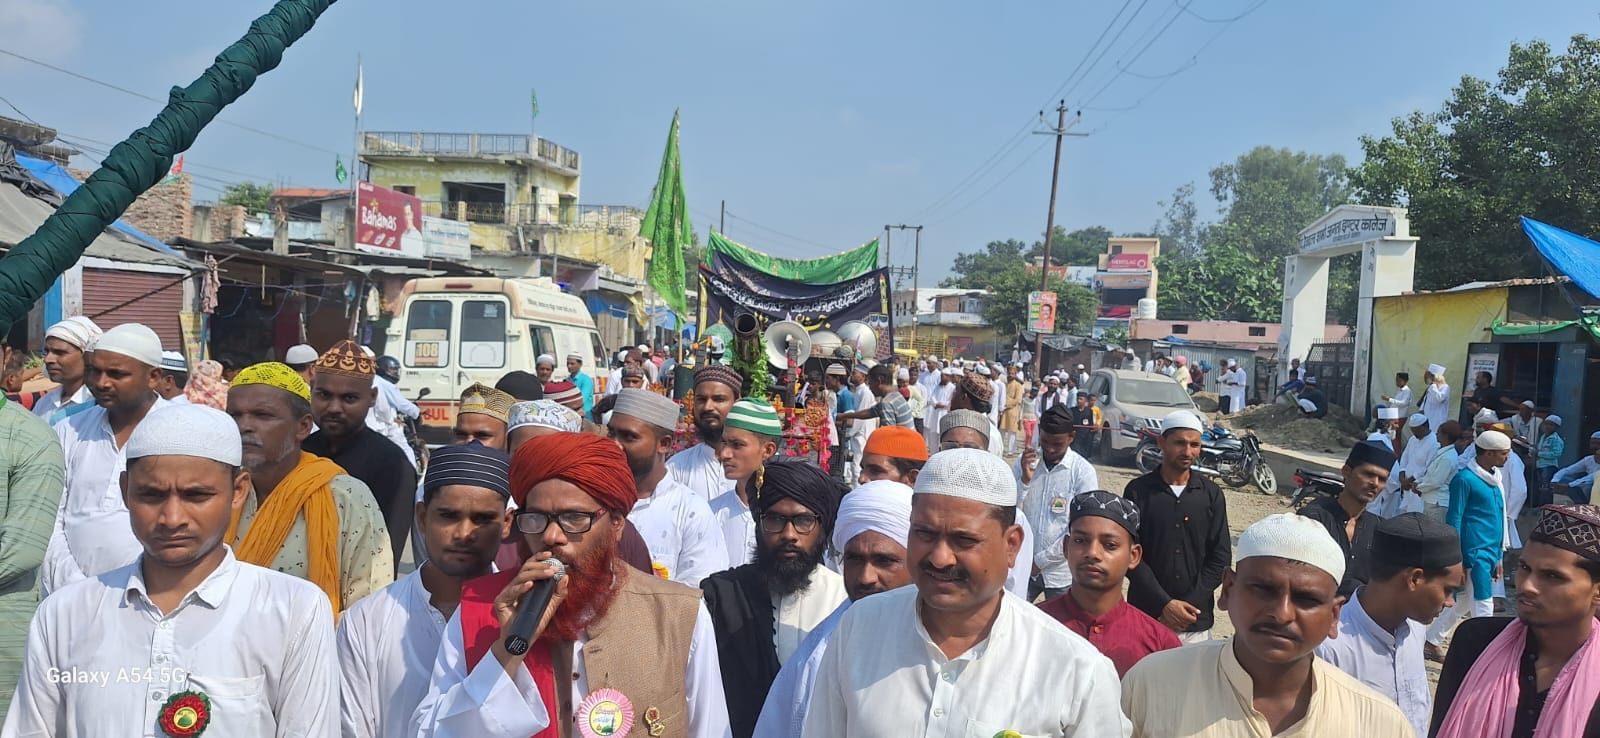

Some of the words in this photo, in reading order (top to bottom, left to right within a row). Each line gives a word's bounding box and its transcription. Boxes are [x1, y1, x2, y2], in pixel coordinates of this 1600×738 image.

[362, 206, 397, 231] Bahamas
[1361, 213, 1387, 232] कालेज
[416, 343, 438, 357] 108
